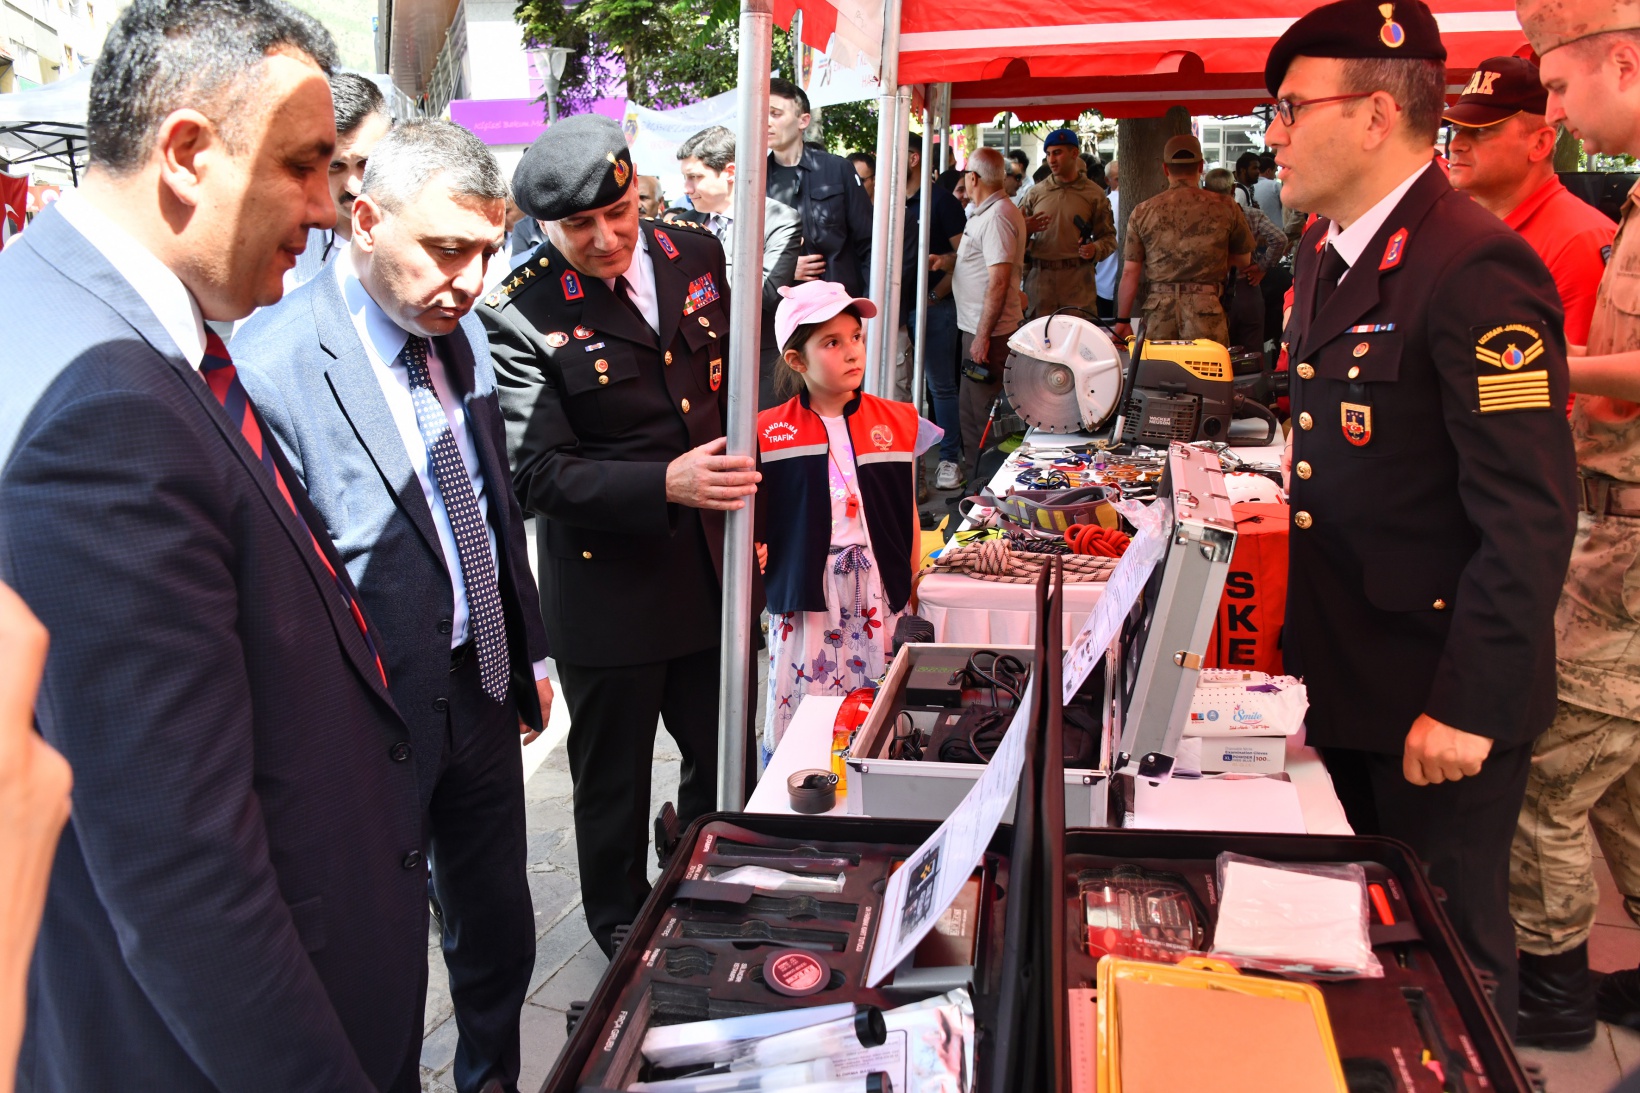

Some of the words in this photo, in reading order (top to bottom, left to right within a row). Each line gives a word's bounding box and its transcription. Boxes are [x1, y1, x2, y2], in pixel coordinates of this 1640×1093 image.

[1478, 326, 1503, 344] UZMAN
[1504, 324, 1539, 340] JANDARMA
[763, 422, 798, 438] JANDARMA
[768, 433, 794, 443] TRAFİK
[1233, 708, 1262, 722] Smile
